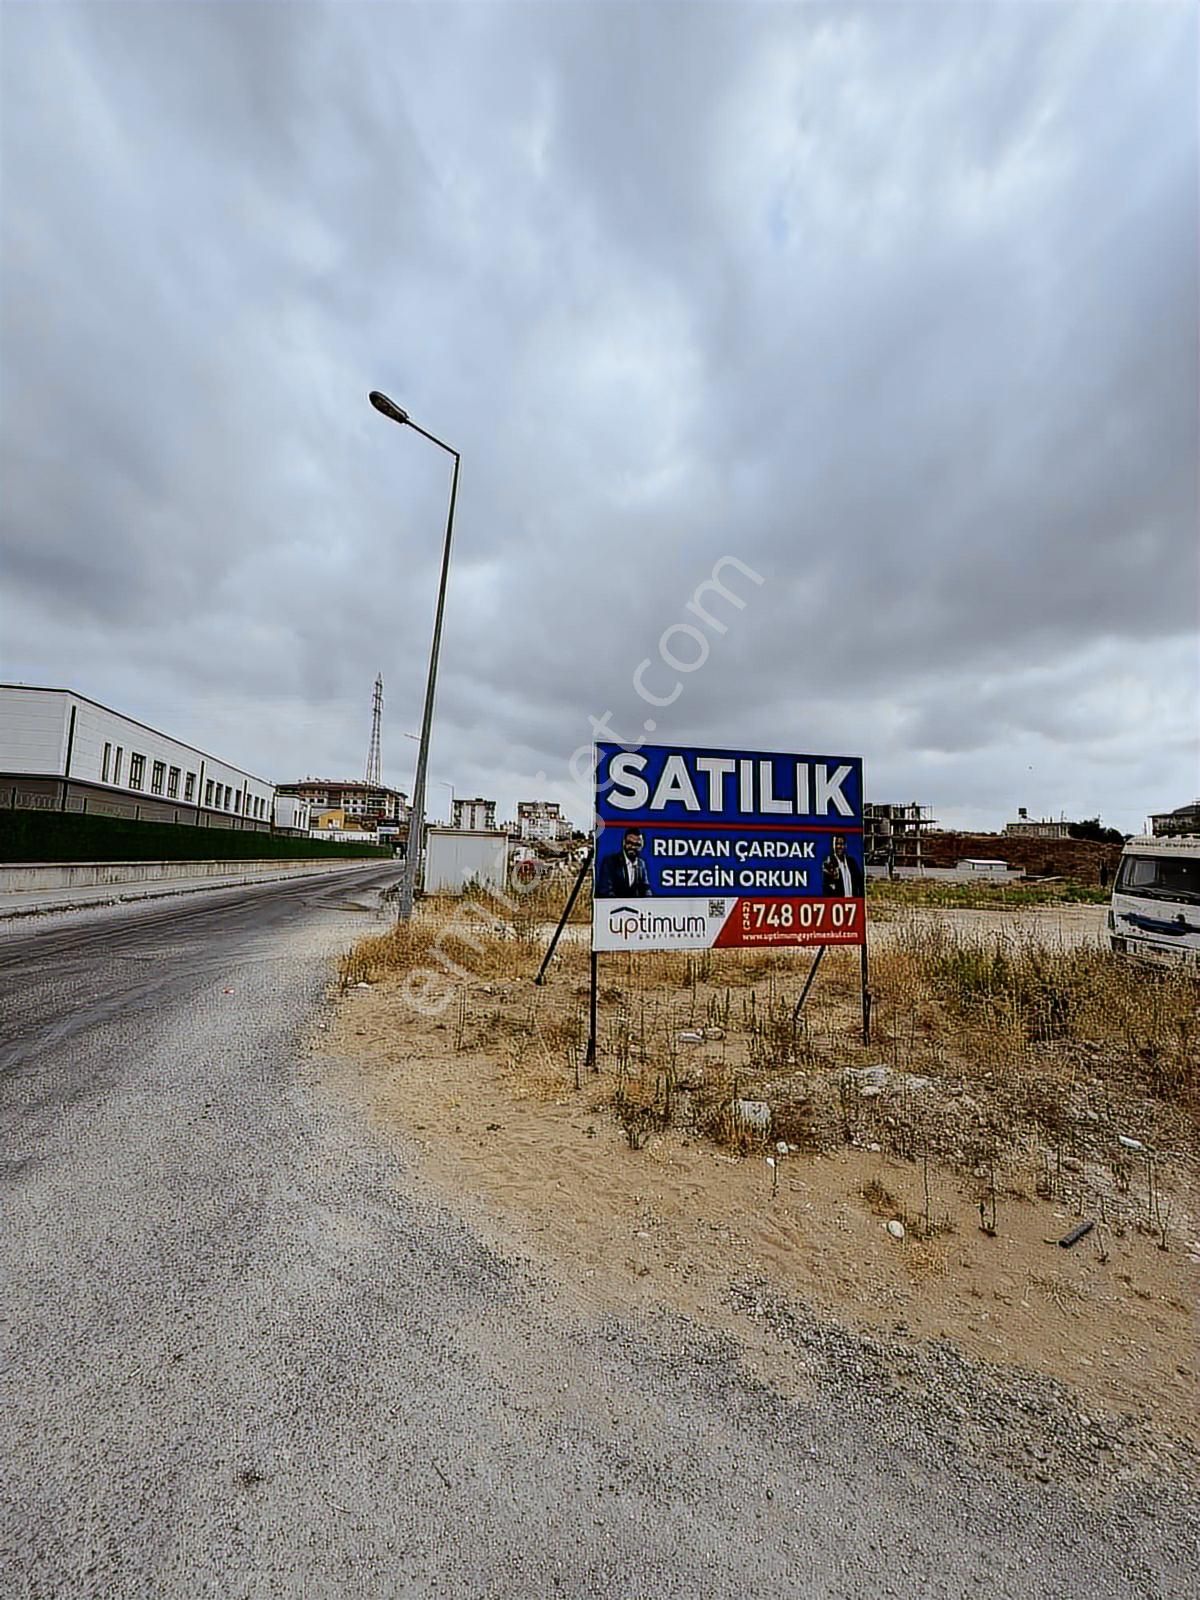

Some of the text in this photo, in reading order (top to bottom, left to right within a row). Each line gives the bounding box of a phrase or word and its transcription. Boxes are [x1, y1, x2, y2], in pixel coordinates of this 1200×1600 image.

[607, 752, 855, 816] SATILIK
[653, 839, 815, 862] RIDVAN ÇARDAK
[661, 865, 808, 887] SEZGİN ORKUN
[609, 911, 706, 940] uptimum
[752, 903, 857, 928] 748 07 07
